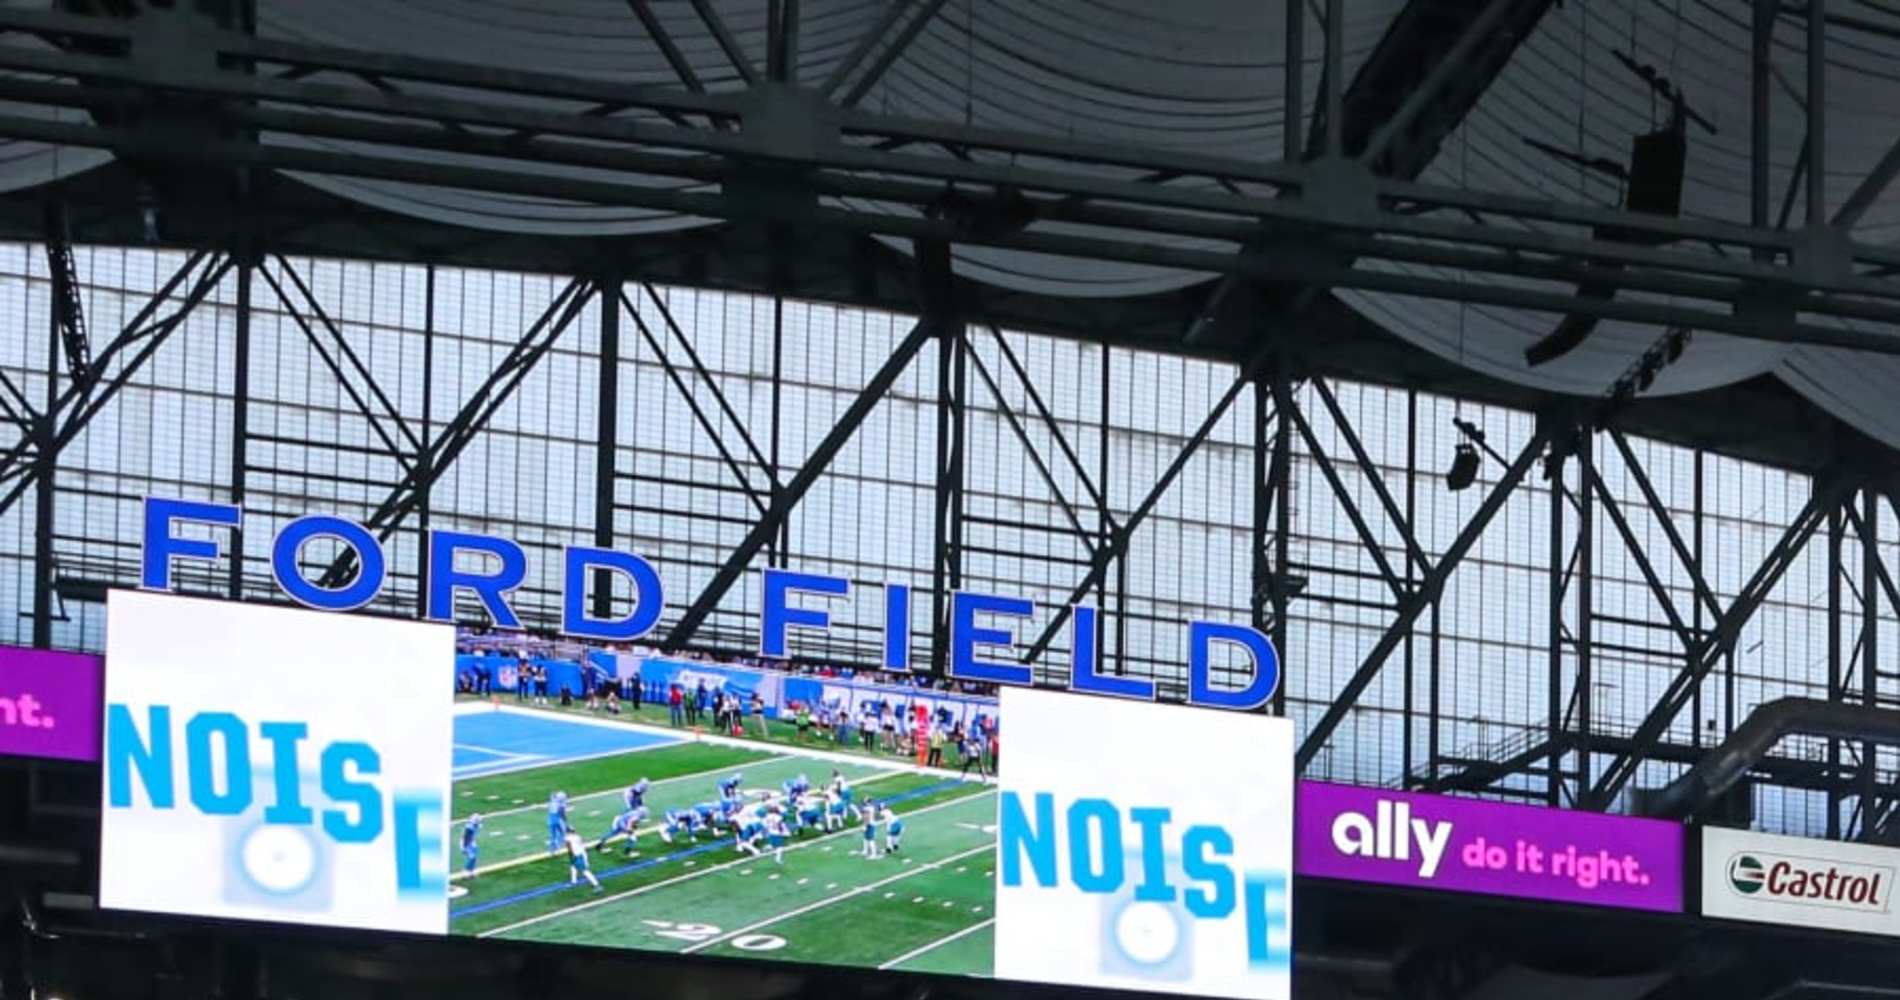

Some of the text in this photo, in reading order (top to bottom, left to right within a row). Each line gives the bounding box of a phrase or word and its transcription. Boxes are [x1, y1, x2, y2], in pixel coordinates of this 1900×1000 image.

[137, 495, 1280, 711] FORD FIELD
[1332, 800, 1650, 888] ally do it right.
[1767, 861, 1881, 905] Castrol
